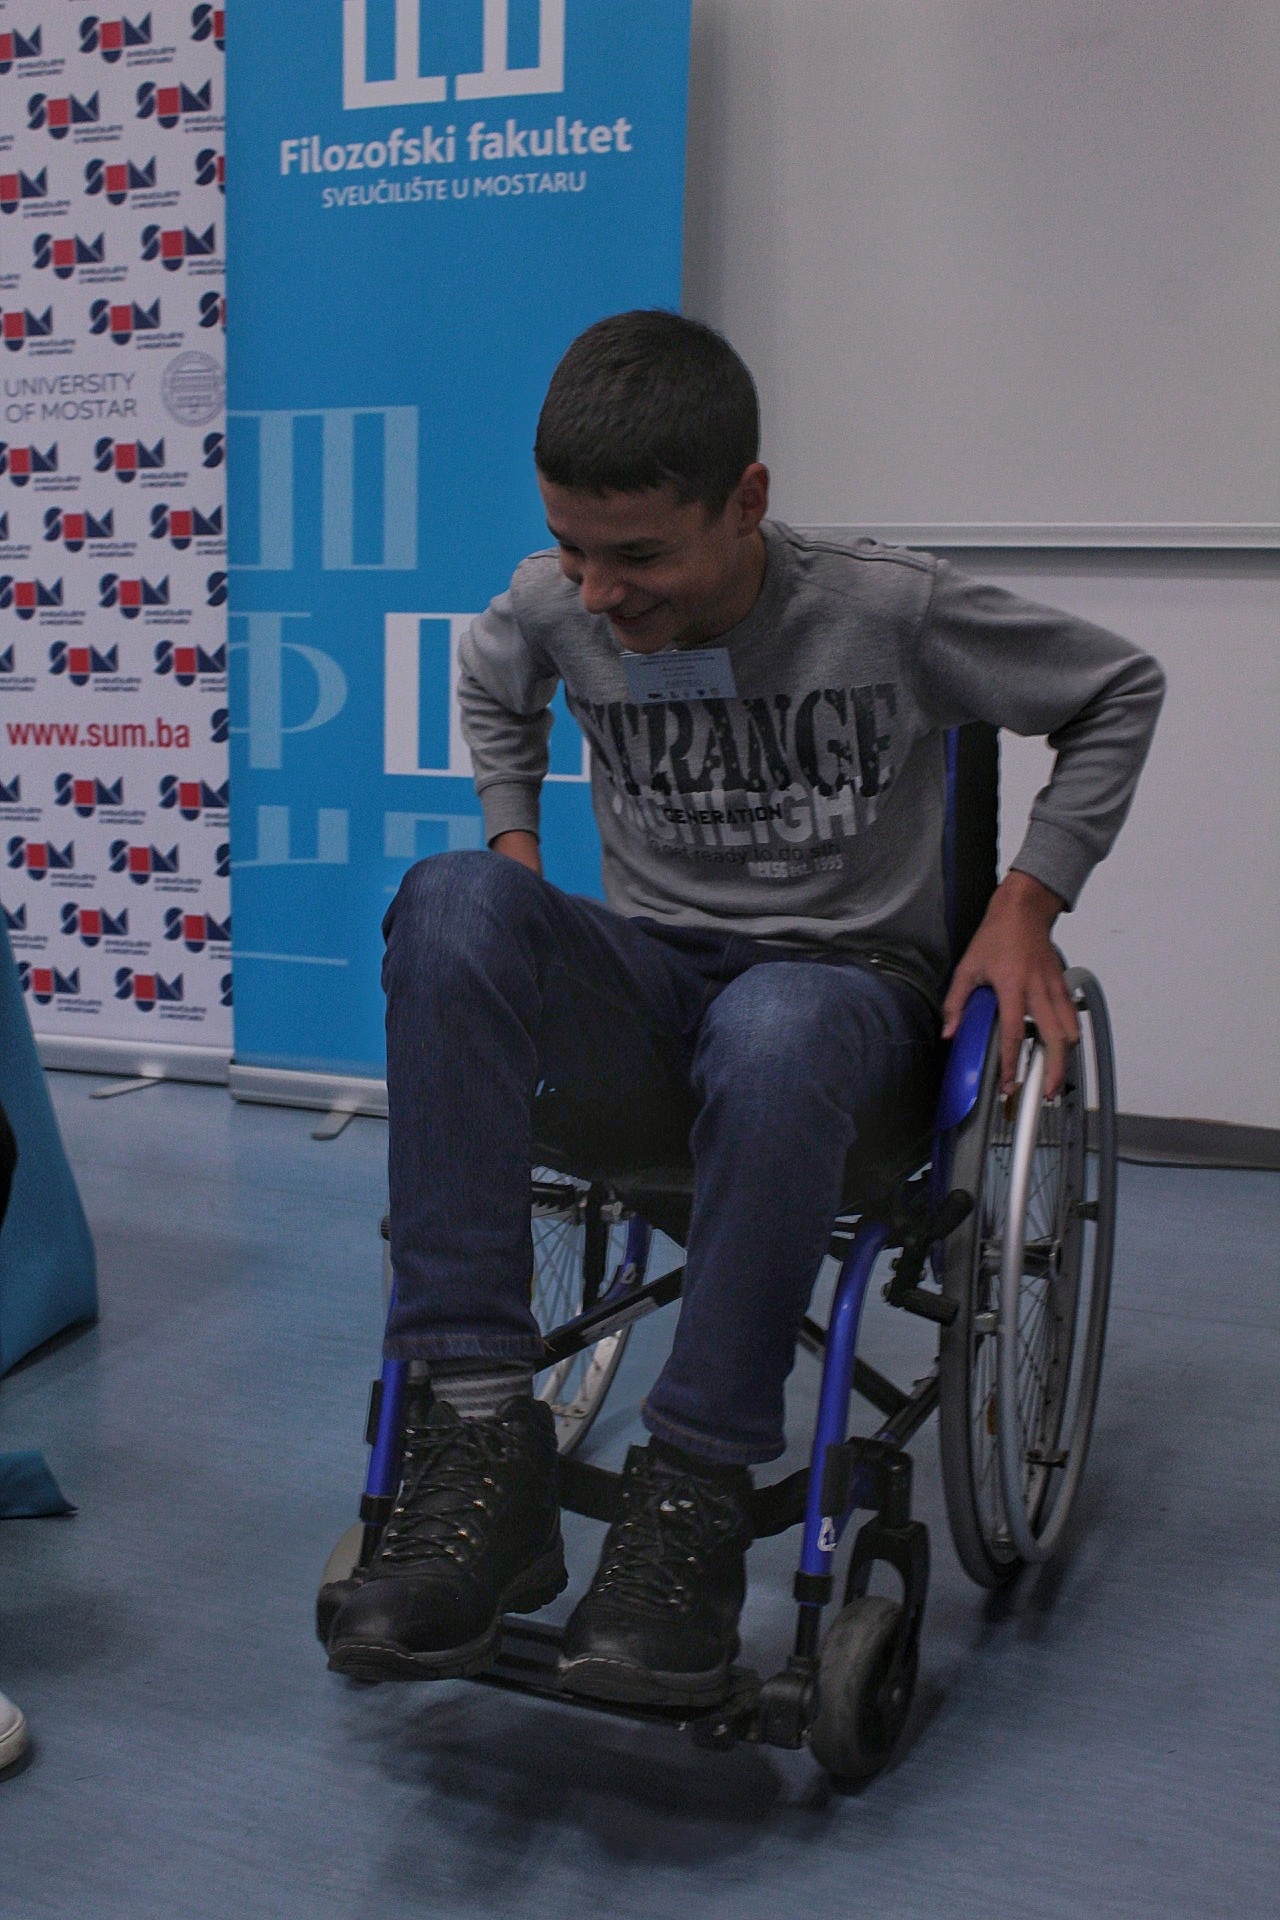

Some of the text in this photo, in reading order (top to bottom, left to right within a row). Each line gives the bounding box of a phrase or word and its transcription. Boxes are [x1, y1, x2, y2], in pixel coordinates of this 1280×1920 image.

[280, 117, 632, 175] Filozofski fakultet
[321, 171, 587, 208] SVEUČILIŠTE U MOSTARU
[4, 373, 136, 397] UNIVERSITY
[6, 399, 138, 424] OF MOSTAR
[7, 718, 190, 749] www.sum.ba
[663, 803, 782, 826] GENERATION
